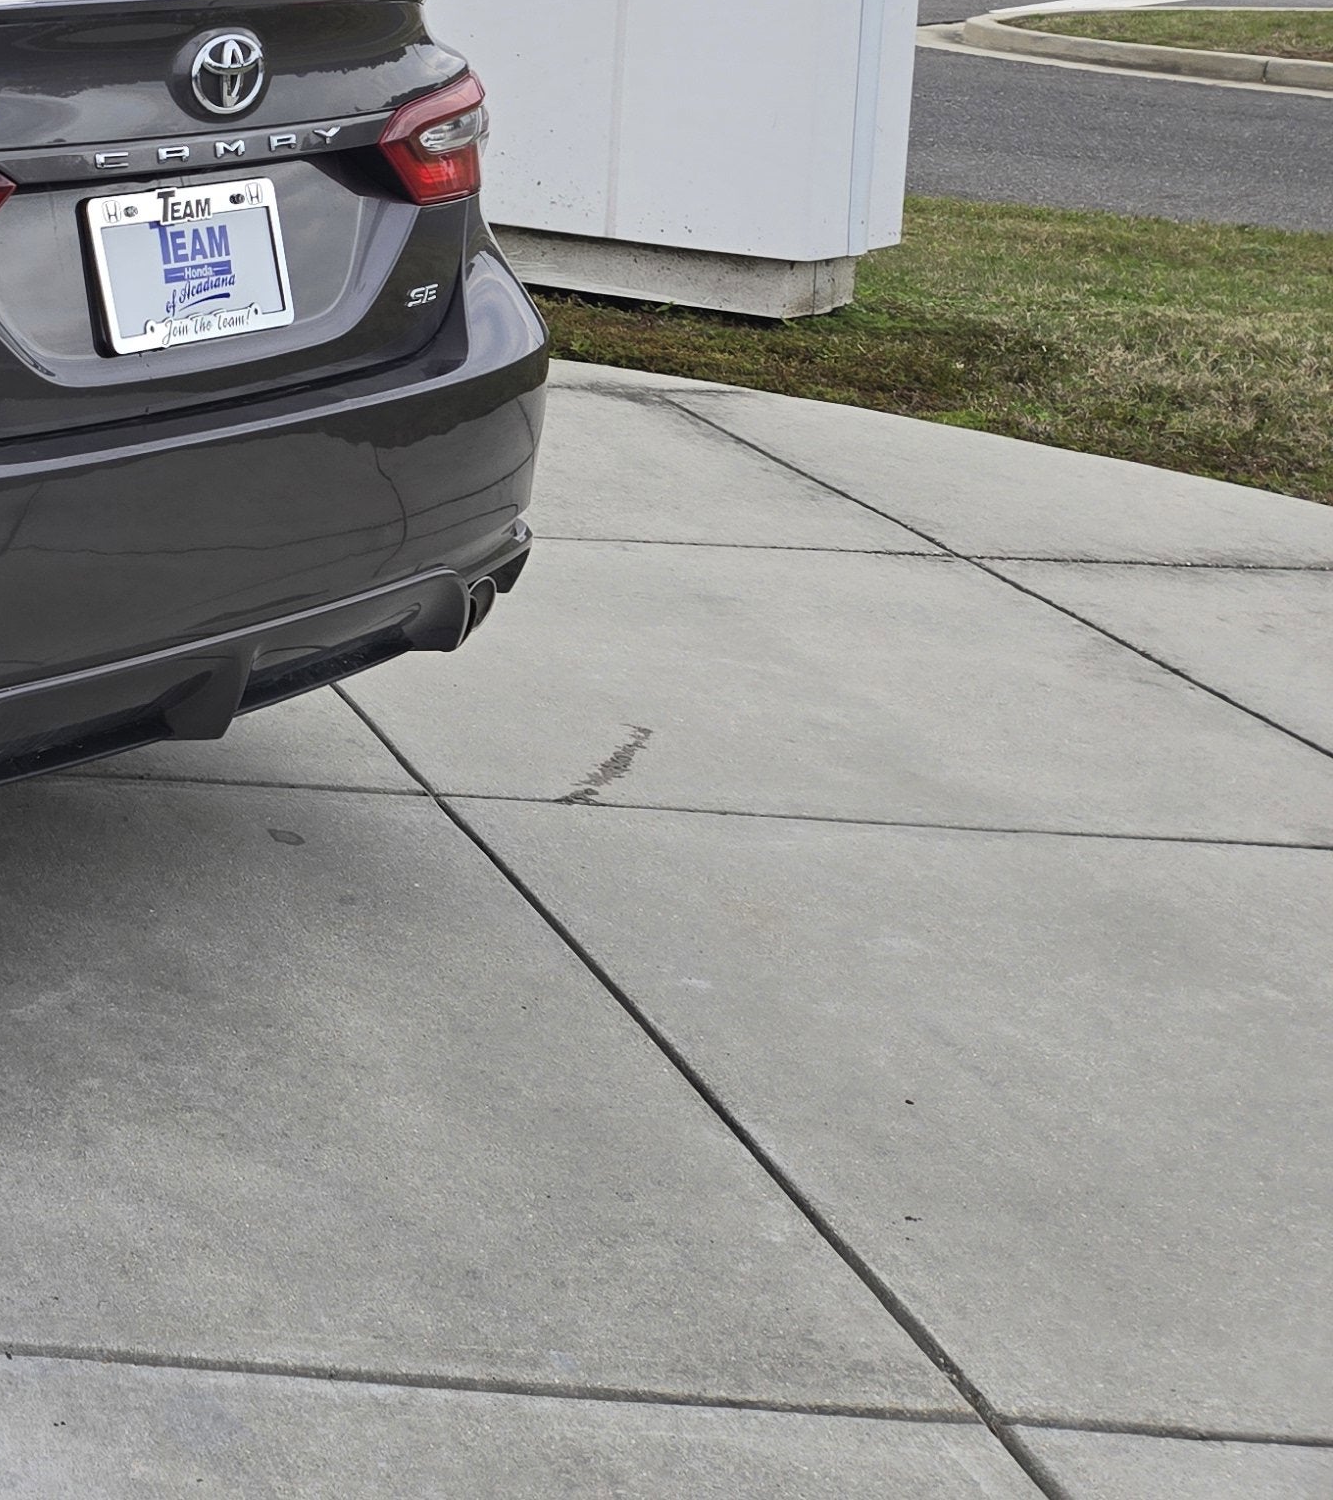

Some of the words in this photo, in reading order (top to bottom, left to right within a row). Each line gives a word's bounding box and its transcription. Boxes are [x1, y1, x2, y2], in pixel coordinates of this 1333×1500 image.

[94, 125, 341, 169] CAMRY
[157, 189, 212, 223] TEAM
[184, 265, 213, 279] Honda
[166, 289, 177, 317] of
[179, 272, 236, 304] Acadiana
[406, 283, 438, 308] SE
[162, 319, 189, 346] Join
[190, 313, 212, 335] The
